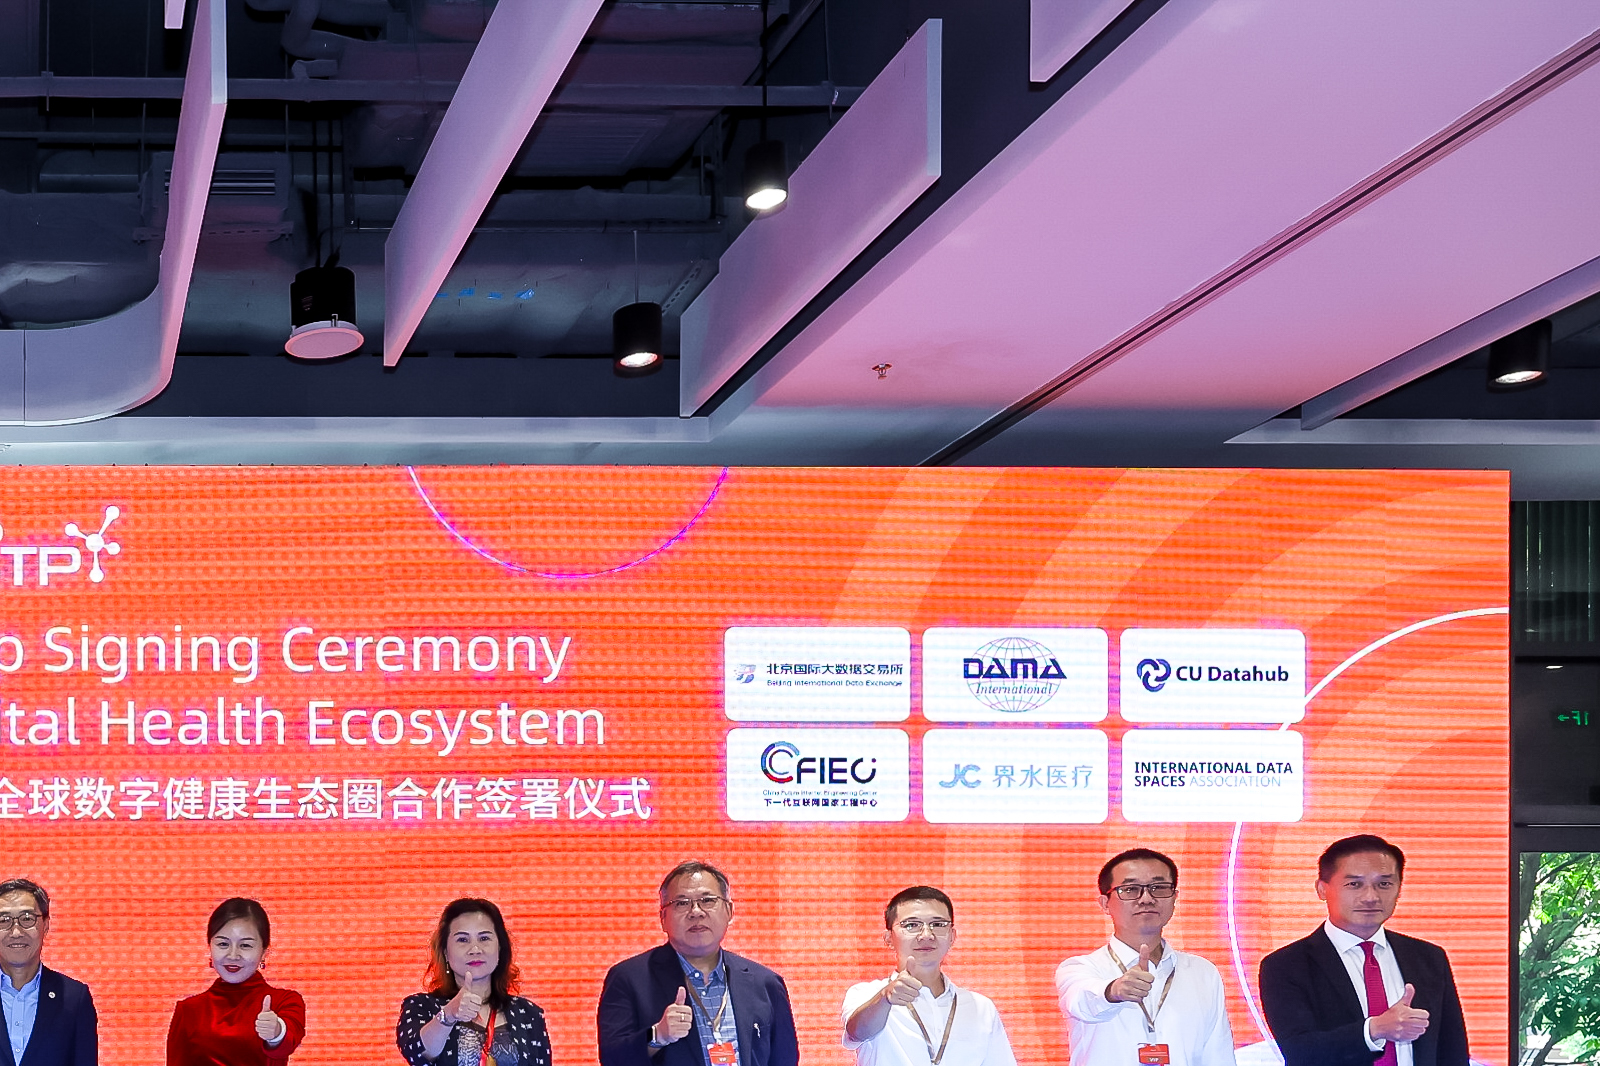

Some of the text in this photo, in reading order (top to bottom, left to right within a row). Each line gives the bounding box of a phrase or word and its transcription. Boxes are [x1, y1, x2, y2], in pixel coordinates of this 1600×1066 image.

[44, 625, 260, 683] Signing
[282, 626, 572, 683] Ceremony
[766, 663, 903, 675] 北京国际大数据交易所
[963, 658, 1068, 679] DAMA
[1176, 665, 1290, 682] CU Datahub
[976, 683, 1053, 695] International
[101, 696, 285, 746] Health
[310, 701, 605, 756] Ecosystem
[992, 764, 1094, 789] 界水医疗
[1134, 762, 1293, 774] INTERNATIONAL DATA
[1134, 776, 1281, 787] SPACES ASSOCIATION
